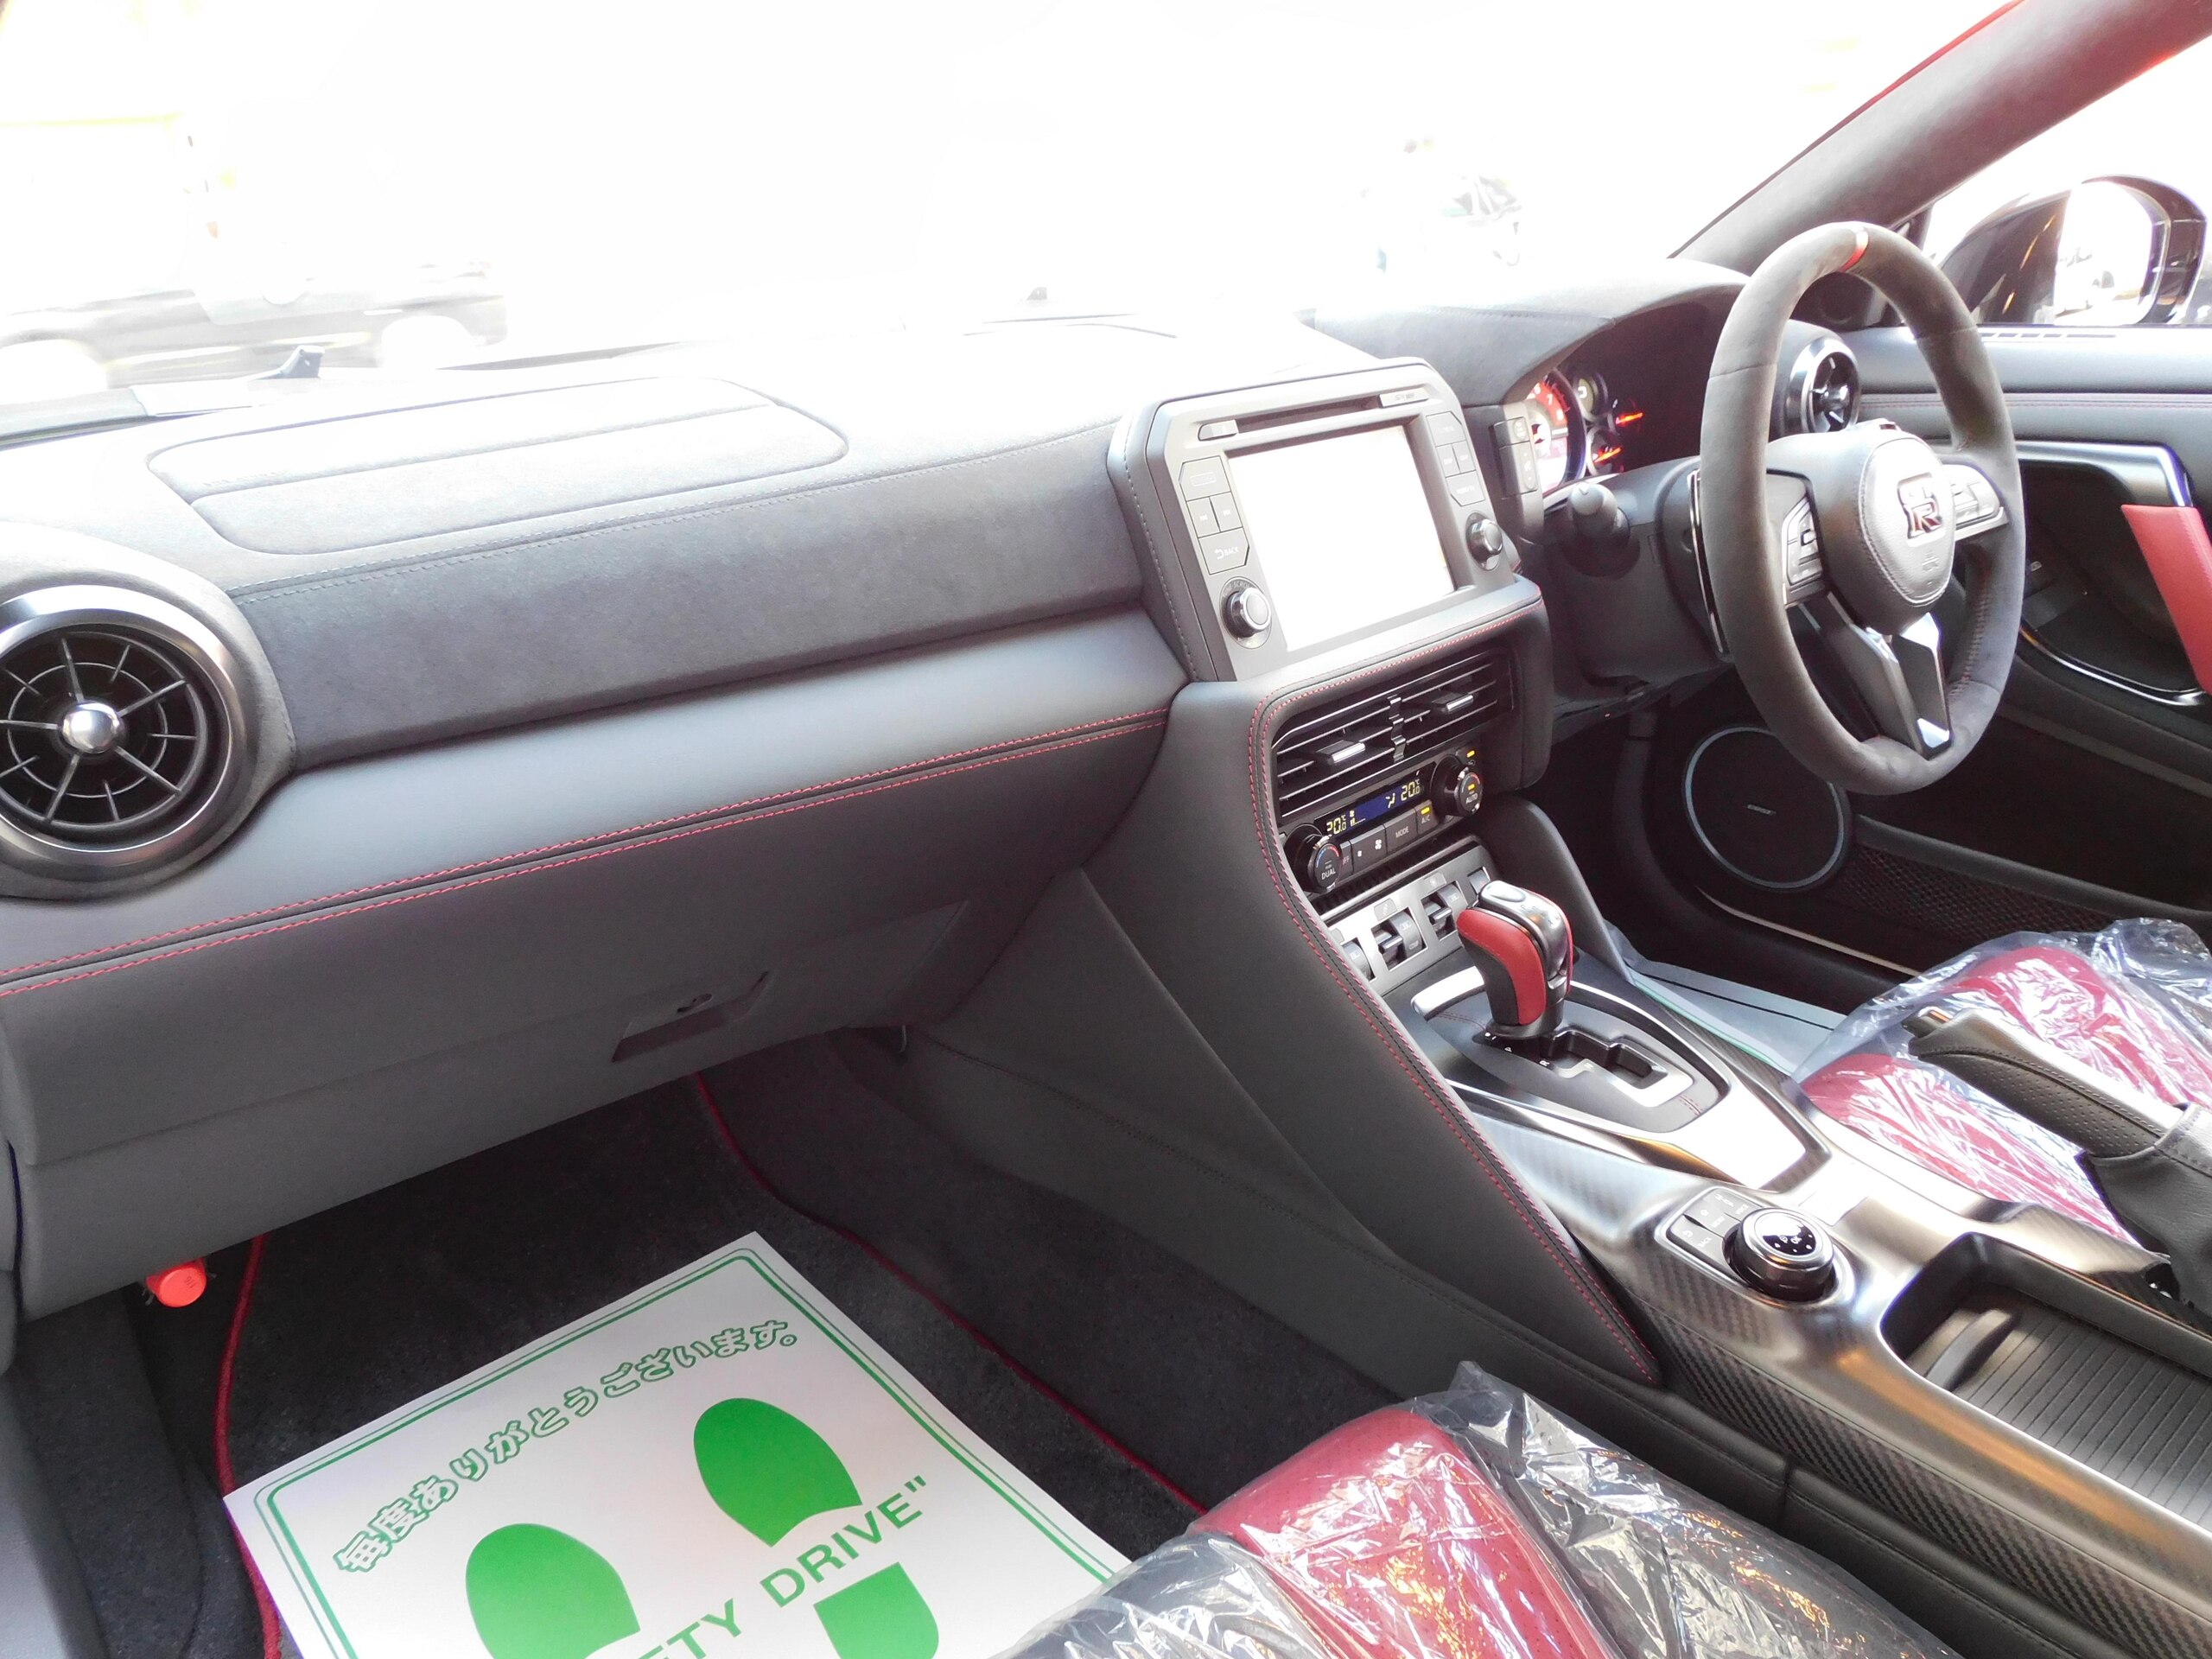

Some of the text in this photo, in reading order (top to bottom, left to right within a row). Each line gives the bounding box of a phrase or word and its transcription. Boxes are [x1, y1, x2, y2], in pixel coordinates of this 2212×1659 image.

[1395, 825, 1409, 838] MODE
[1321, 868, 1337, 880] DUAL
[333, 1319, 798, 1573] 毎度ありがとうございます。
